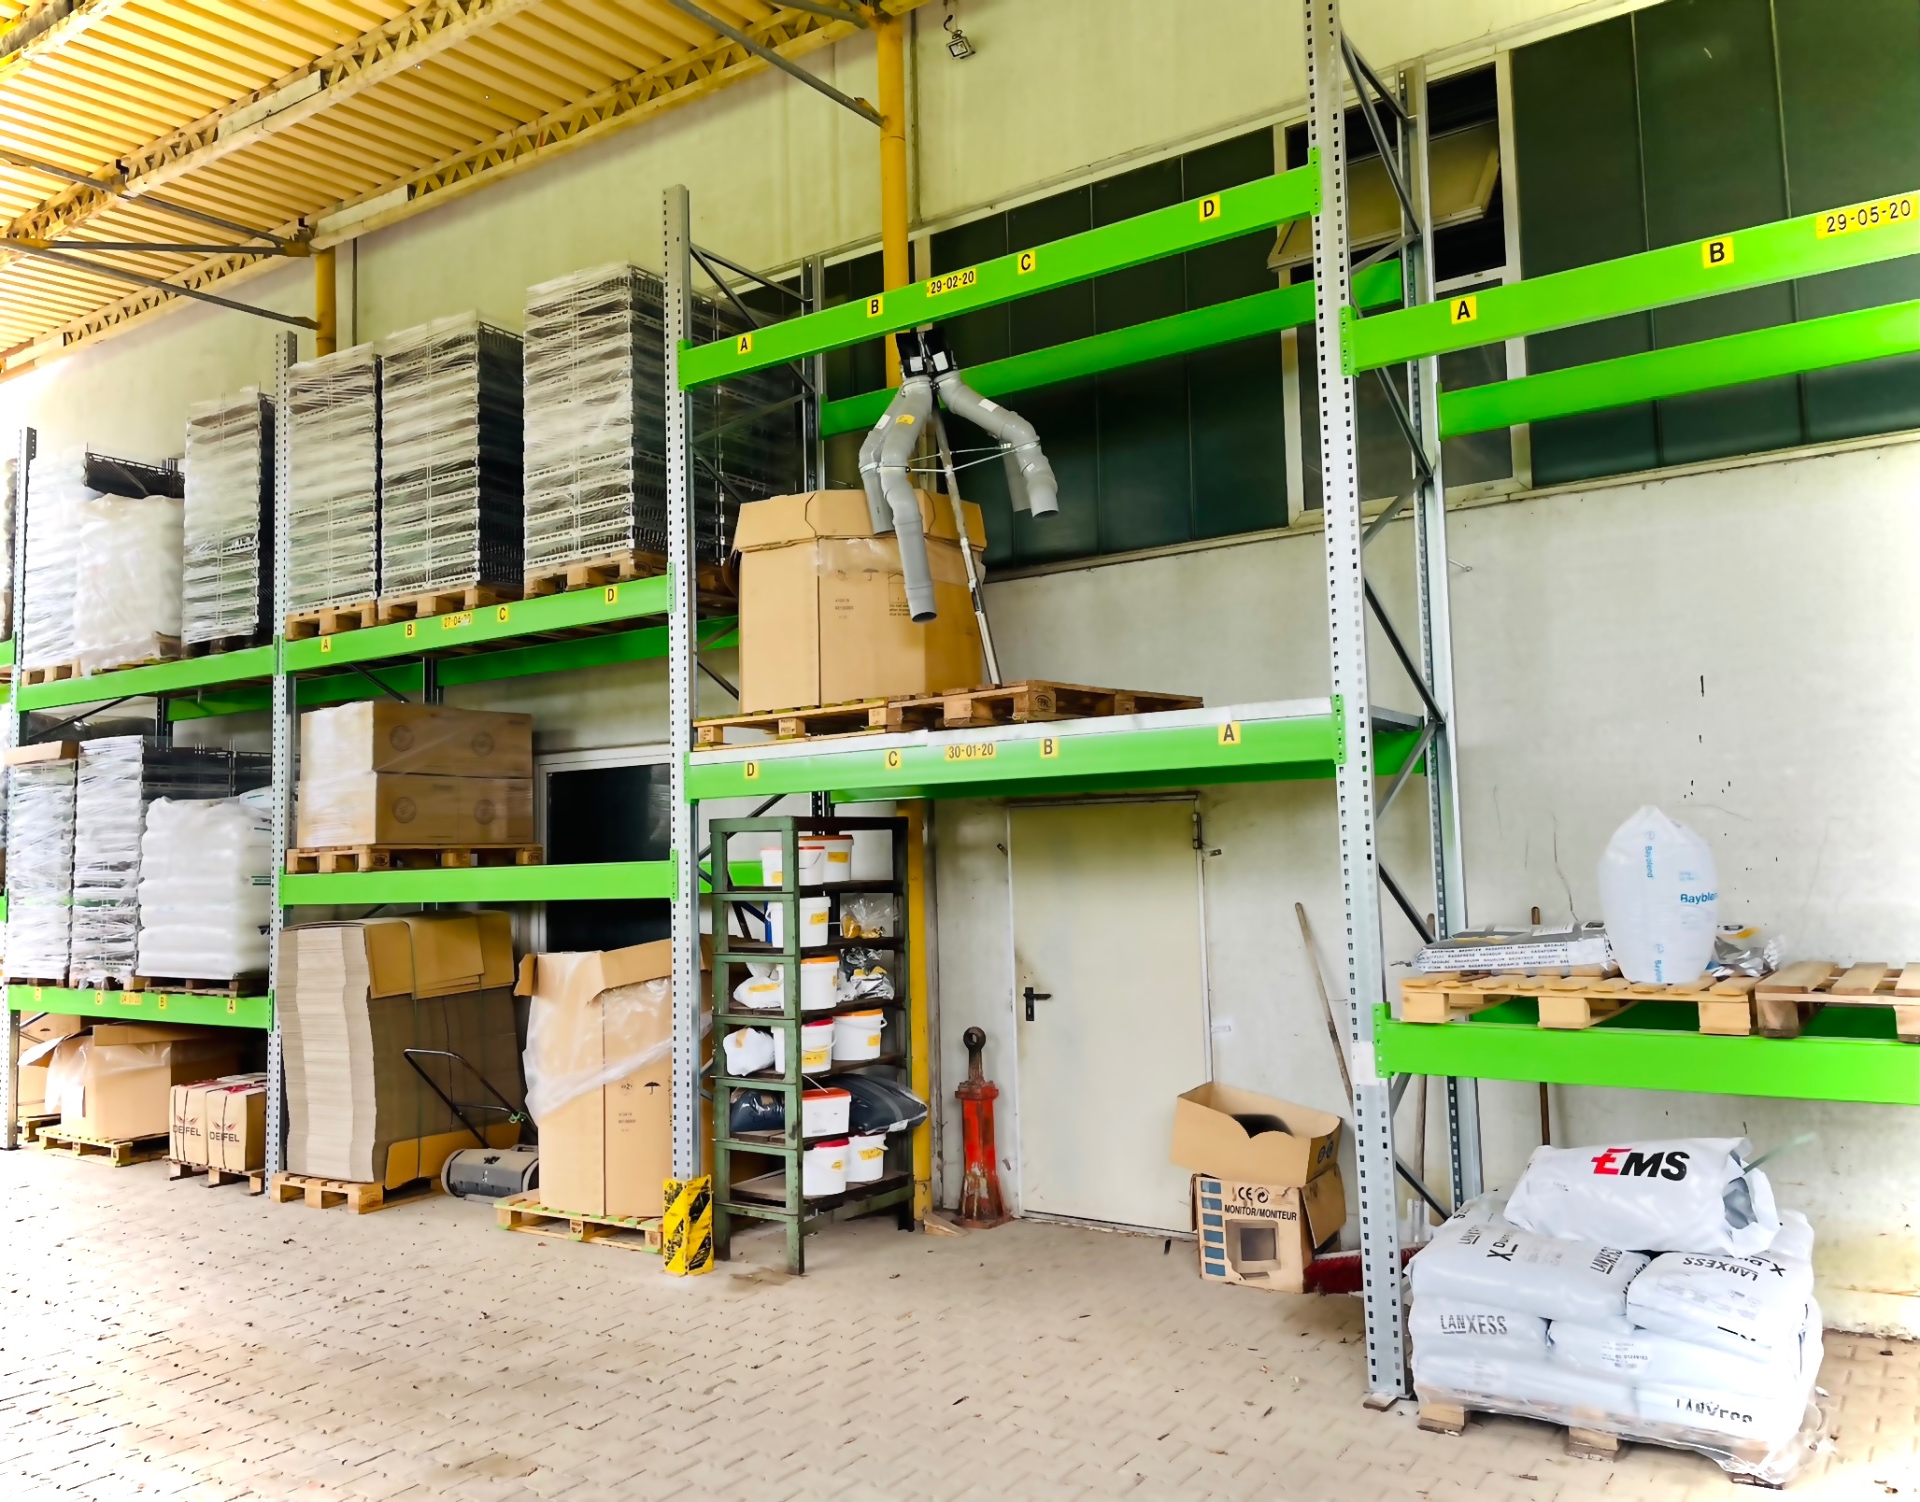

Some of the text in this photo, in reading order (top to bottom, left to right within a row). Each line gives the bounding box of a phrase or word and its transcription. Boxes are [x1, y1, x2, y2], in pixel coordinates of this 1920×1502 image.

[1203, 200, 1215, 218] D
[1825, 200, 1912, 234] 29-05-20
[1709, 242, 1725, 262] B
[1020, 254, 1032, 271] C
[930, 271, 975, 295] 29-02-20
[871, 299, 879, 314] B
[1456, 301, 1472, 320] A
[740, 338, 748, 351] A
[607, 588, 615, 602] D
[499, 607, 506, 621] C
[406, 624, 413, 636] B
[322, 639, 329, 650] A
[1222, 724, 1235, 742] A
[947, 742, 994, 760] 30-01-20
[1043, 738, 1053, 756] B
[888, 750, 898, 767] C
[746, 762, 756, 777] D
[1590, 1147, 1690, 1182] EMS
[1237, 1186, 1254, 1201] CE
[1224, 1204, 1298, 1222] MONITOR/MONITEUR
[1682, 1256, 1759, 1282] LANXESS
[1440, 1314, 1508, 1335] LANXESS
